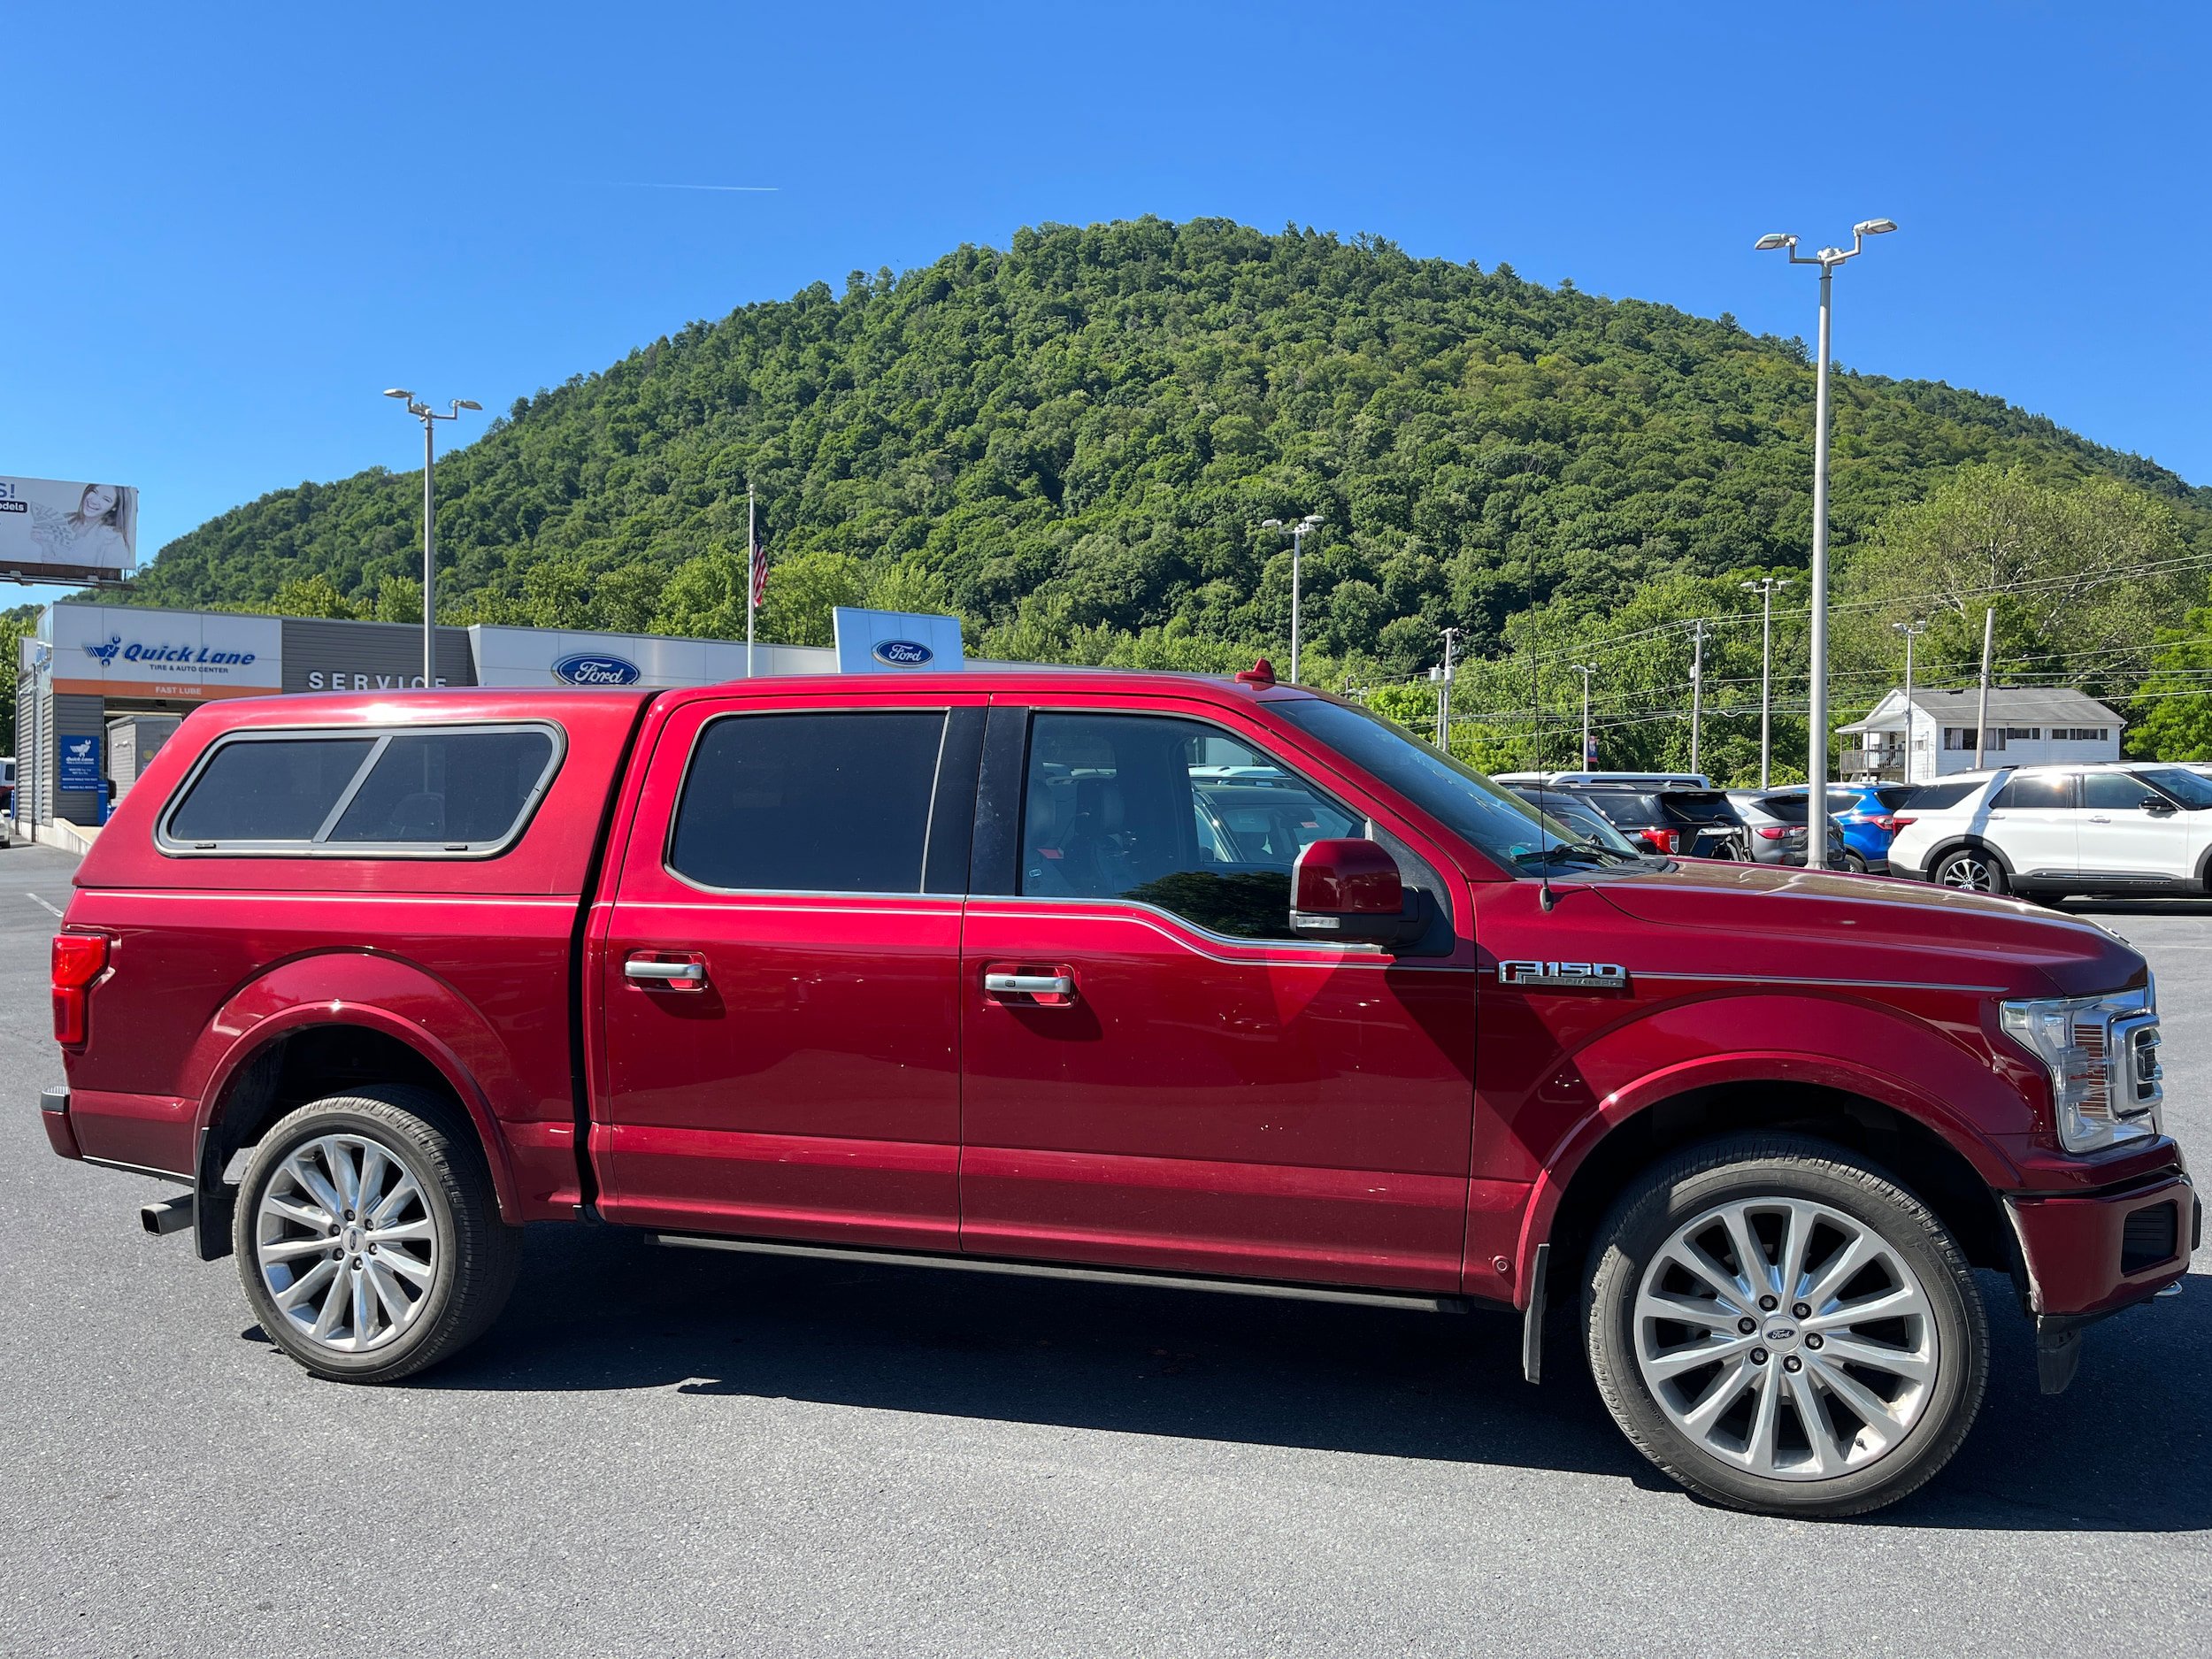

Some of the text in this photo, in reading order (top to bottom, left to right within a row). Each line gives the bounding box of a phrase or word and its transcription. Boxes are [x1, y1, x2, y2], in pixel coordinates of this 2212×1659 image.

[124, 643, 256, 665] Quick Lane
[888, 644, 922, 661] Ford
[574, 661, 625, 683] Ford
[179, 687, 203, 695] LUBE
[1771, 1330, 1791, 1339] Ford
